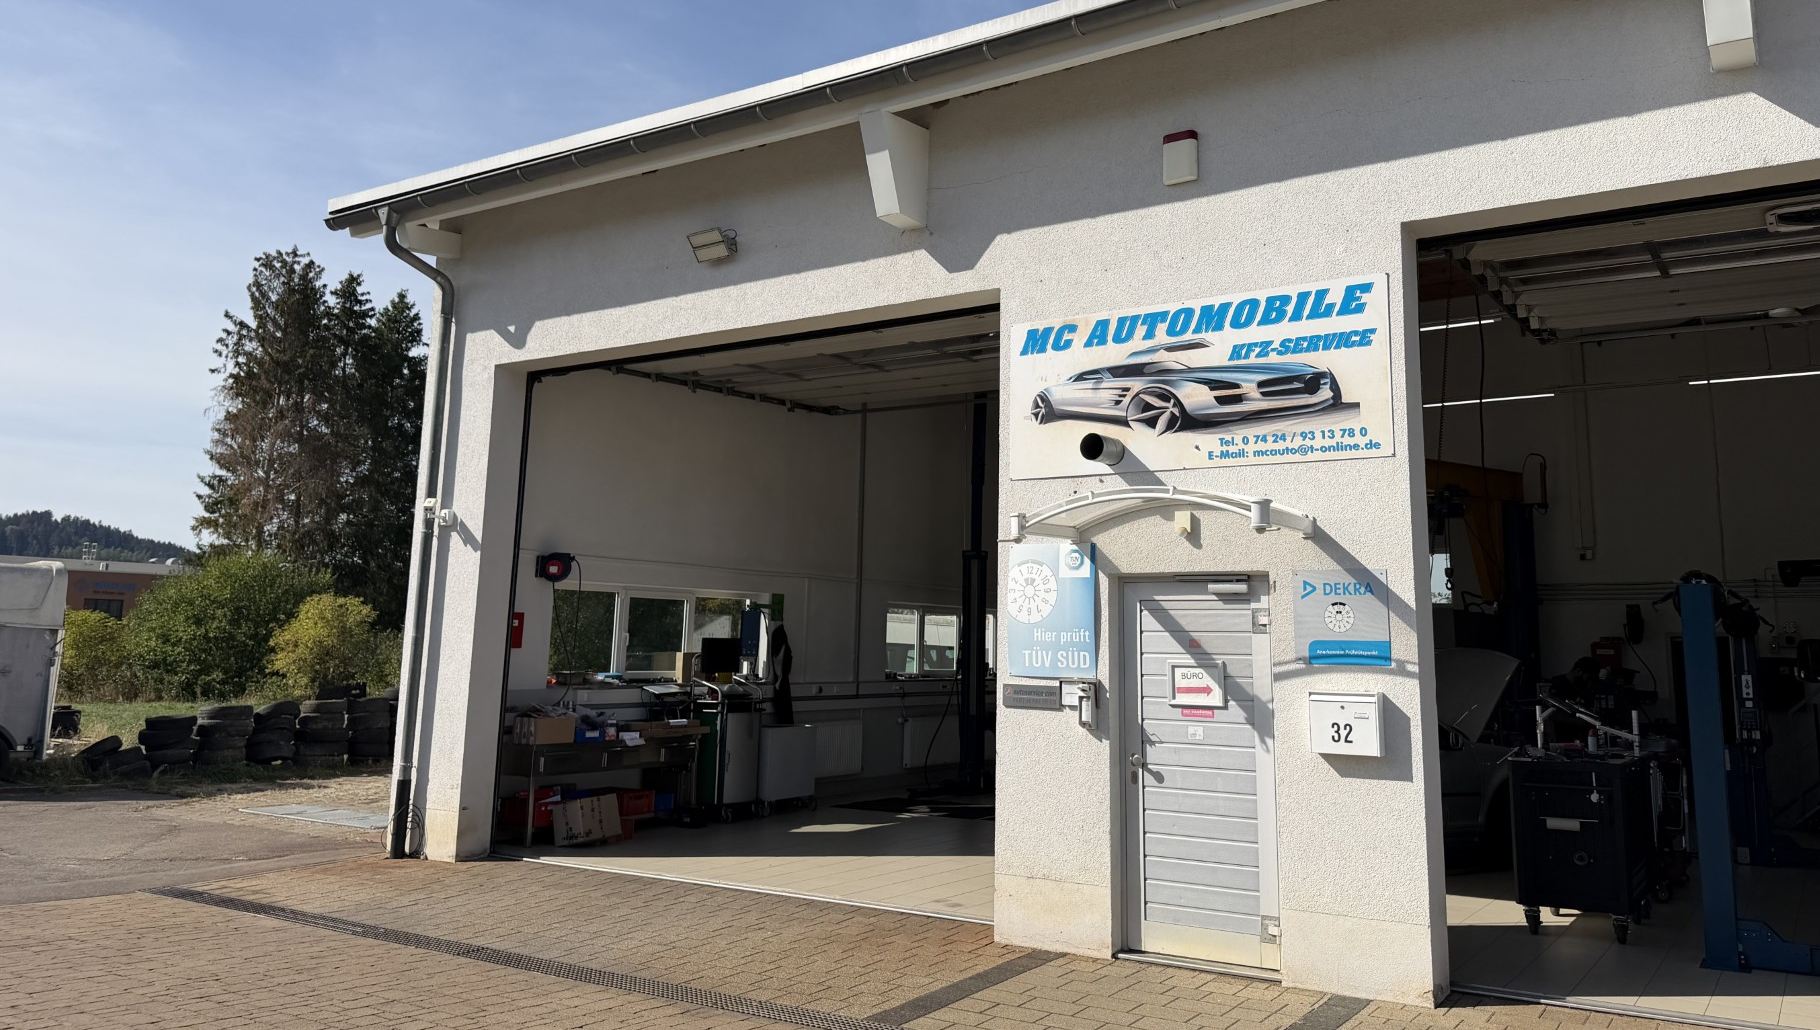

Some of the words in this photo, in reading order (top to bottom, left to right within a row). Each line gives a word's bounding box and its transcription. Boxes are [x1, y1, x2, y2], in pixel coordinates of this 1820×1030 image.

[1019, 323, 1078, 356] MC
[1083, 281, 1375, 348] AUTOMOBILE
[1227, 327, 1378, 362] KFZ-SERVICE
[1218, 437, 1238, 447] Tel.
[1242, 435, 1250, 446] 0
[1253, 434, 1268, 445] 74
[1272, 432, 1287, 444] 24
[1290, 431, 1297, 443] /
[1300, 430, 1316, 442] 93
[1320, 429, 1335, 440] 13
[1339, 427, 1356, 438] 78
[1360, 427, 1368, 437] 0
[1208, 448, 1249, 460] E-Mail:
[1252, 439, 1382, 458] mcauto@t-online.de
[1026, 566, 1034, 575] 12
[1035, 568, 1043, 578] 11
[1042, 575, 1050, 586] 10
[1322, 582, 1375, 596] DEKRA
[1034, 628, 1057, 642] Hier
[1060, 629, 1090, 644] prüft
[1023, 647, 1052, 668] TÜV
[1057, 647, 1090, 668] SÜD
[1181, 670, 1204, 680] BÜRO
[1331, 722, 1354, 743] 32
